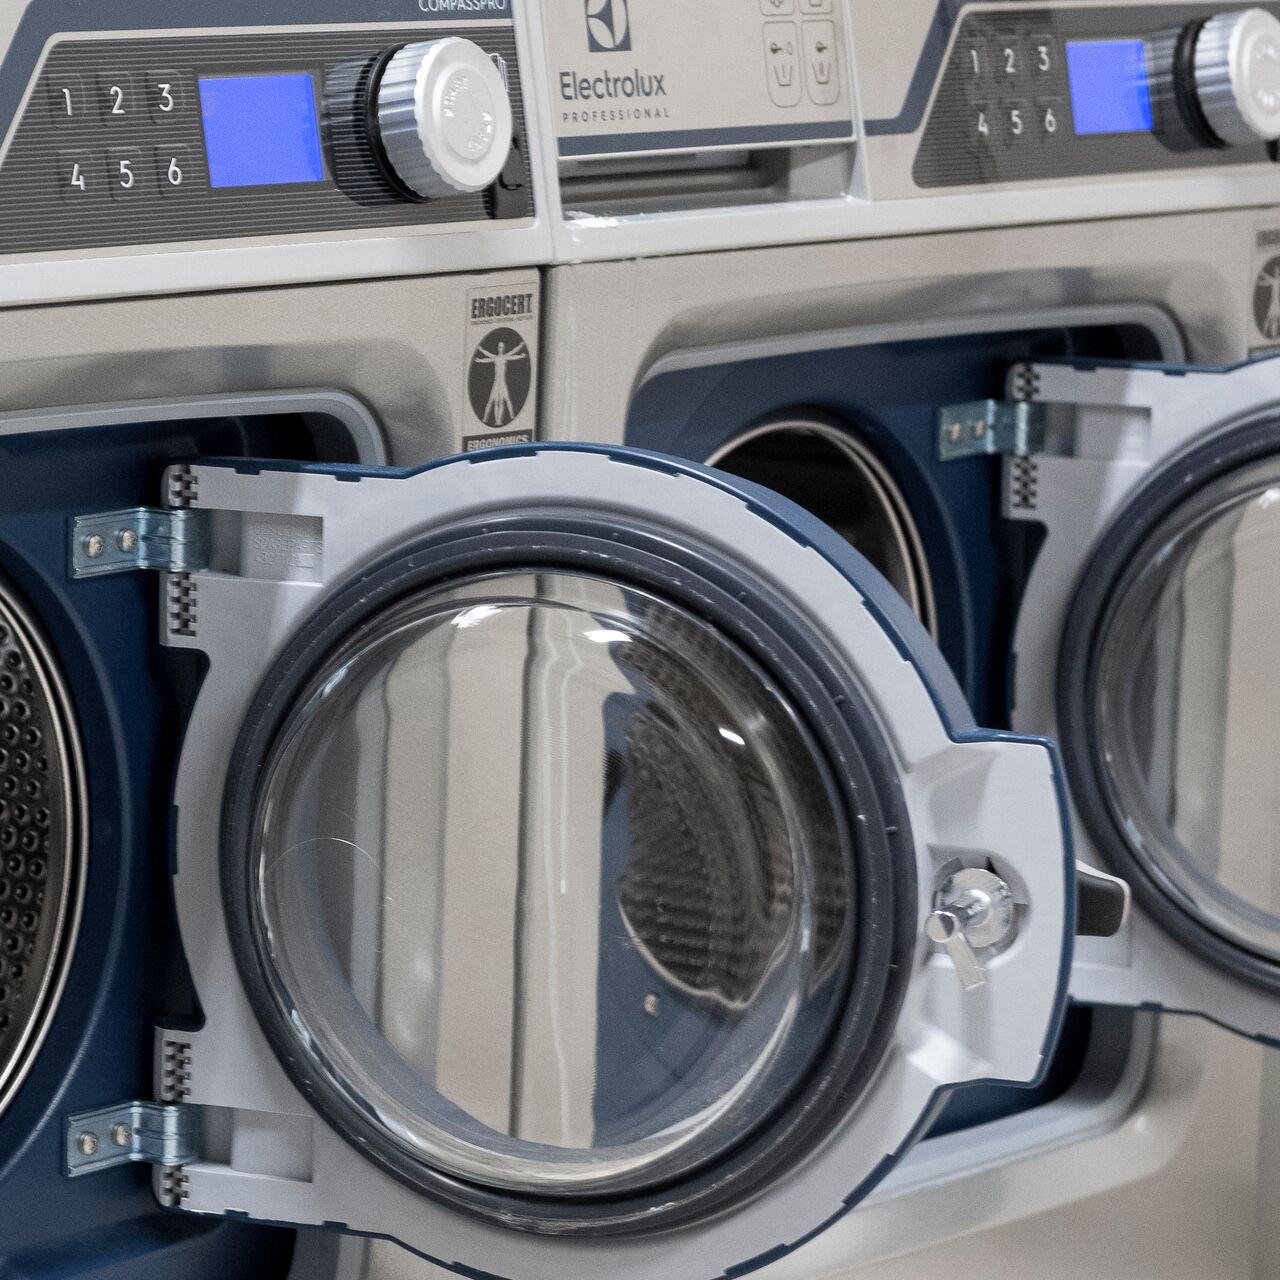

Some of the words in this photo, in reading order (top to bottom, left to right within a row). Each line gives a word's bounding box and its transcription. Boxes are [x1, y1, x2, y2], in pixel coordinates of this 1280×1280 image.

[970, 49, 979, 74] 1
[1003, 47, 1016, 73] 2
[1037, 45, 1050, 71] 3
[559, 68, 667, 100] Electrolux
[61, 88, 73, 116] 1
[109, 86, 126, 114] 2
[157, 83, 175, 112] 3
[562, 107, 670, 123] PROFESSIONAL
[977, 111, 989, 136] 4
[1010, 109, 1024, 135] 5
[1044, 107, 1057, 133] 6
[70, 163, 86, 191] 4
[119, 160, 135, 189] 5
[167, 157, 183, 185] 6
[471, 293, 533, 319] ERGOCERT
